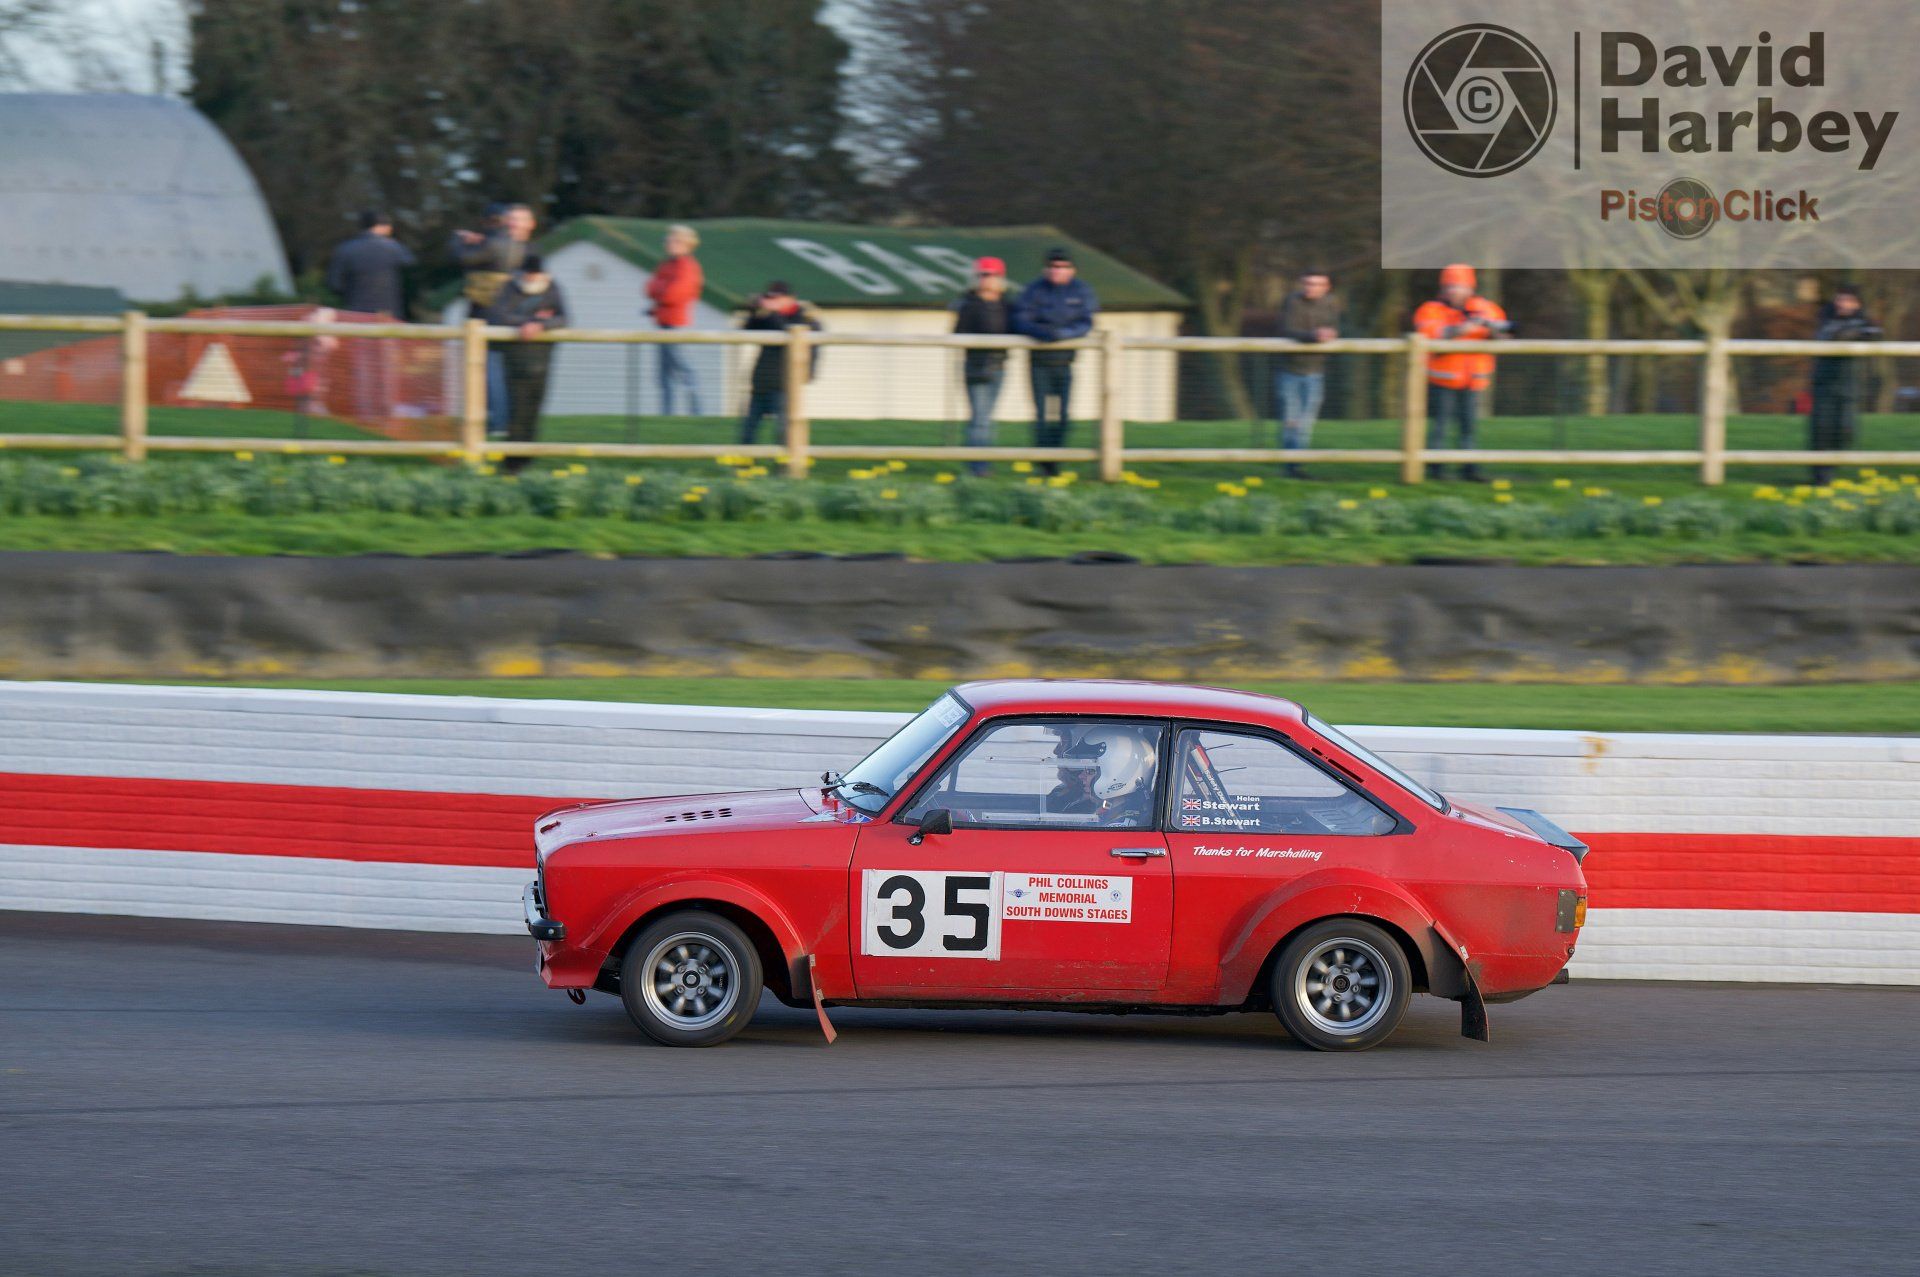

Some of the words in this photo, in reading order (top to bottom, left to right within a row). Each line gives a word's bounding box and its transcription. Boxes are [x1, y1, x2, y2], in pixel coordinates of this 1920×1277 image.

[1202, 800, 1260, 811] Stewart
[1202, 816, 1260, 827] B.Stewart
[1193, 846, 1232, 857] Thanks
[1235, 847, 1254, 857] for
[1255, 847, 1323, 862] Marshalling
[1028, 877, 1053, 888] PHIL
[1057, 878, 1109, 890] COLLINGS
[1039, 892, 1097, 904] MEMORIAL
[877, 874, 991, 952] 35
[1006, 906, 1041, 917] SOUTH
[1045, 907, 1084, 919] DOWNS
[1087, 909, 1128, 920] STAGES
